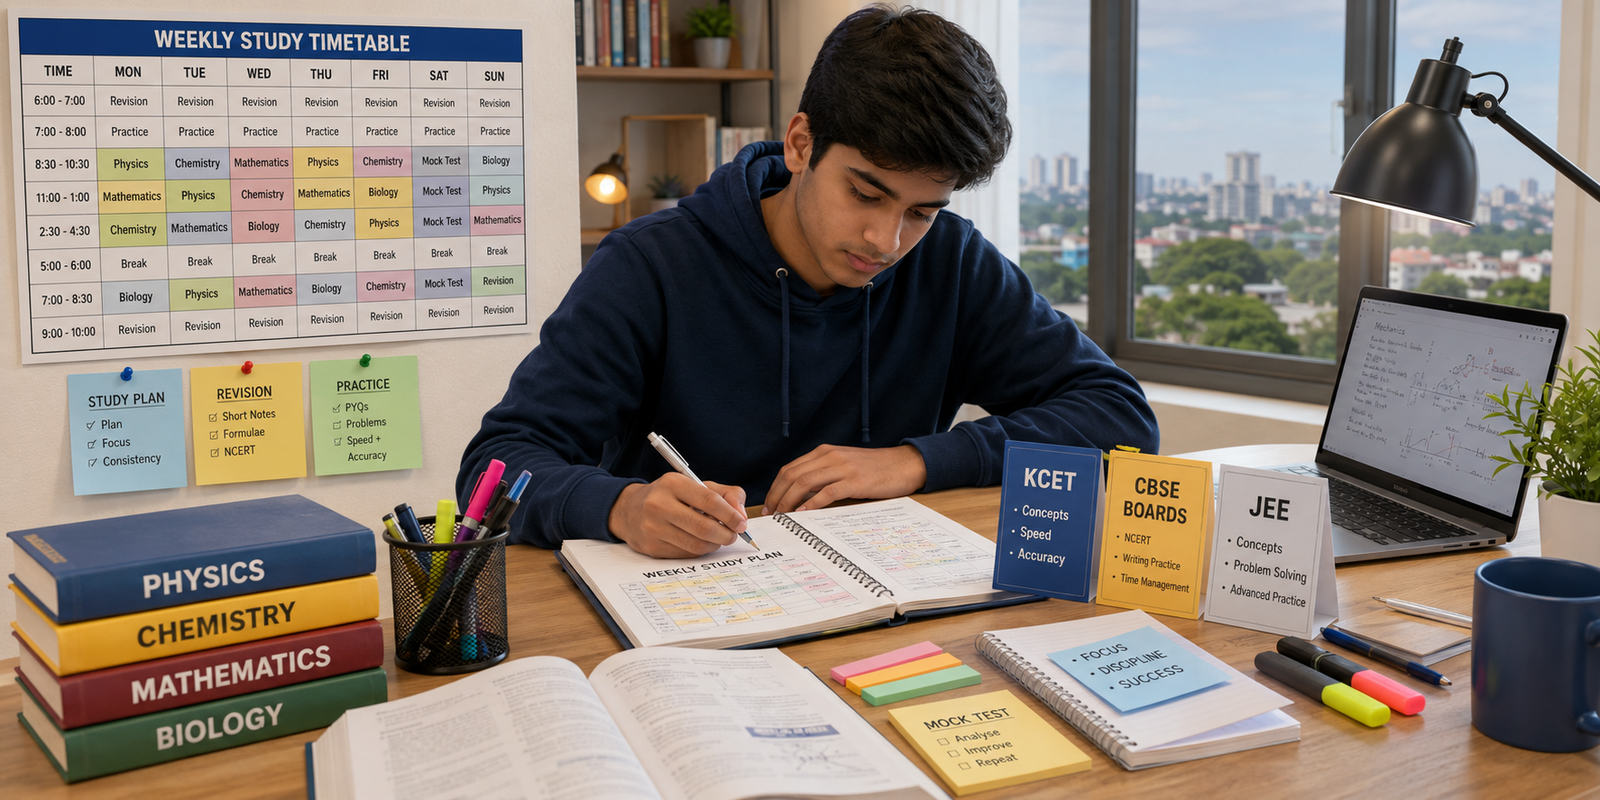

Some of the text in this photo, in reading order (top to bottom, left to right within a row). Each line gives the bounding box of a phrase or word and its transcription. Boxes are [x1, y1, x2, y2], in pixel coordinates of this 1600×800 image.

[154, 30, 410, 52] WEEKLY STUDY TIMETABLE
[44, 65, 72, 76] TIME
[115, 66, 141, 77] MON
[184, 67, 205, 78] TUE
[247, 68, 271, 78] WED
[311, 69, 331, 79] THU
[373, 70, 388, 80] FRI
[430, 70, 448, 80] SAT
[485, 71, 504, 81] SUN
[35, 95, 55, 105] 6:00
[65, 96, 85, 105] 7:00
[111, 96, 147, 106] Revision
[178, 97, 213, 106] Revision
[243, 97, 277, 106] Revision
[305, 97, 338, 106] Revision
[365, 98, 397, 107] Revision
[424, 98, 455, 107] Revision
[480, 99, 510, 107] Revision
[35, 127, 56, 136] 7:00
[66, 127, 86, 136] 8:00
[112, 127, 148, 136] Practice
[179, 127, 214, 136] Practice
[244, 127, 277, 136] Practice
[306, 127, 339, 136] Practice
[366, 127, 398, 135] Practice
[425, 127, 455, 135] Practice
[481, 127, 510, 135] Practice
[36, 160, 56, 169] 8:30
[65, 159, 89, 169] 10:30
[114, 159, 148, 171] Physics
[175, 158, 220, 170] Chemistry
[235, 158, 289, 167] Mathematics
[308, 157, 338, 168] Physics
[363, 157, 403, 168] Chemistry
[423, 156, 460, 165] Mock Test
[483, 156, 510, 167] Biology
[182, 190, 215, 202] Physics
[242, 189, 284, 200] Chemistry
[298, 188, 350, 198] Mathematics
[369, 187, 398, 198] Biology
[423, 186, 461, 195] Mock Test
[483, 185, 510, 196] Physics
[37, 193, 60, 202] 11:00
[71, 192, 89, 202] 1:00
[103, 192, 161, 201] Mathematics
[305, 220, 346, 230] Chemistry
[370, 218, 399, 229] Physics
[424, 217, 462, 226] Mock Test
[474, 215, 521, 224] Mathematics
[40, 227, 60, 236] 2:30
[70, 226, 90, 235] 4:30
[111, 224, 156, 236] Chemistry
[172, 222, 228, 233] Mathematics
[249, 221, 279, 232] Biology
[374, 250, 396, 259] Break
[432, 248, 453, 257] Break
[487, 246, 508, 255] Break
[188, 256, 213, 266] Break
[252, 254, 276, 264] Break
[314, 252, 337, 261] Break
[41, 261, 61, 271] 5:00
[71, 260, 91, 270] 6:00
[122, 258, 147, 268] Break
[366, 281, 406, 291] Chemistry
[425, 278, 463, 288] Mock Test
[483, 276, 513, 285] Revision
[186, 289, 218, 301] Physics
[239, 286, 292, 296] Mathematics
[312, 284, 341, 295] Biology
[42, 295, 62, 305] 7:00
[72, 294, 92, 304] 8:30
[120, 292, 152, 303] Biology
[429, 308, 459, 317] Revision
[484, 305, 514, 314] Revision
[311, 315, 344, 324] Revision
[371, 311, 402, 321] Revision
[185, 321, 220, 331] Revision
[249, 318, 283, 327] Revision
[42, 328, 63, 338] 9:00
[72, 327, 95, 337] 10:00
[119, 324, 155, 334] Revision
[337, 379, 390, 391] PRACTICE
[217, 386, 271, 399] REVISION
[89, 392, 164, 407] STUDY PLAN
[346, 402, 368, 413] PYQs
[223, 410, 275, 421] Short Notes
[102, 419, 122, 429] Plan
[347, 418, 386, 428] Problems
[224, 427, 265, 438] Formulae
[103, 438, 130, 448] Focus
[347, 435, 373, 447] Speed
[225, 445, 255, 456] NCERT
[103, 455, 161, 466] Consistency
[348, 453, 386, 461] Accuracy
[1024, 468, 1076, 491] KCET
[1135, 477, 1180, 499] CBSE
[1023, 505, 1068, 521] Concepts
[1124, 501, 1187, 524] BOARDS
[1249, 496, 1290, 521] JEE
[1021, 526, 1051, 540] Speed
[1125, 533, 1151, 544] NCERT
[1237, 536, 1282, 555] Concepts
[1018, 548, 1065, 567] Accuracy
[1123, 554, 1180, 570] Writing Practice
[643, 550, 784, 579] WEEKLY STUDY PLAN
[1234, 560, 1306, 585] Problem Solving
[143, 559, 266, 599] PHYSICS
[1121, 573, 1189, 593] Time Management
[1230, 584, 1306, 607] Advanced Practice
[138, 601, 296, 648] CHEMISTRY
[1081, 644, 1128, 661] FOCUS
[1098, 650, 1168, 675] DISCIPLINE
[131, 645, 331, 705] MATHEMATICS
[1118, 664, 1185, 689] SUCCESS
[924, 708, 1010, 731] MOCK TEST
[156, 703, 284, 751] BIOLOGY
[955, 729, 1001, 745] Analyse
[964, 740, 1012, 757] Improve
[975, 753, 1018, 769] Repeat
